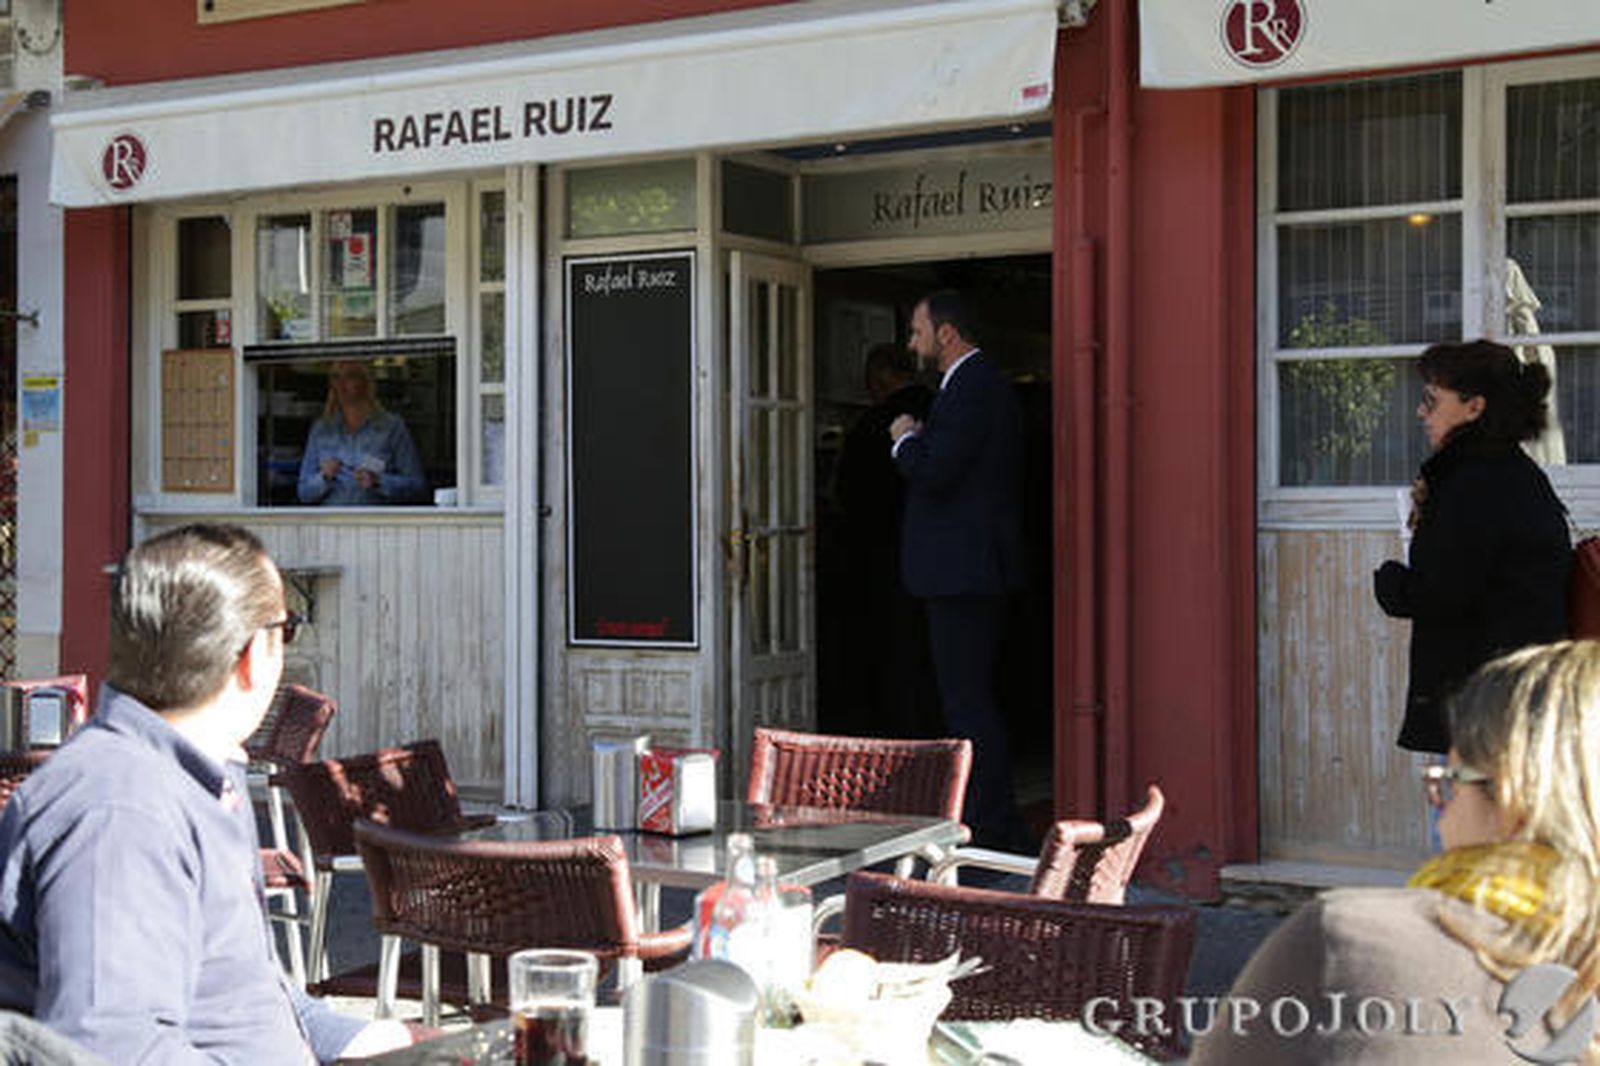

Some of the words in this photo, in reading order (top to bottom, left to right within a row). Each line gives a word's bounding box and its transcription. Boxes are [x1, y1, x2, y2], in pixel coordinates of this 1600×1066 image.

[373, 105, 512, 152] RAFAEL
[523, 94, 613, 137] RUIZ
[872, 169, 966, 230] Rafael
[979, 173, 1053, 213] Ruiz
[585, 263, 634, 296] Rafael
